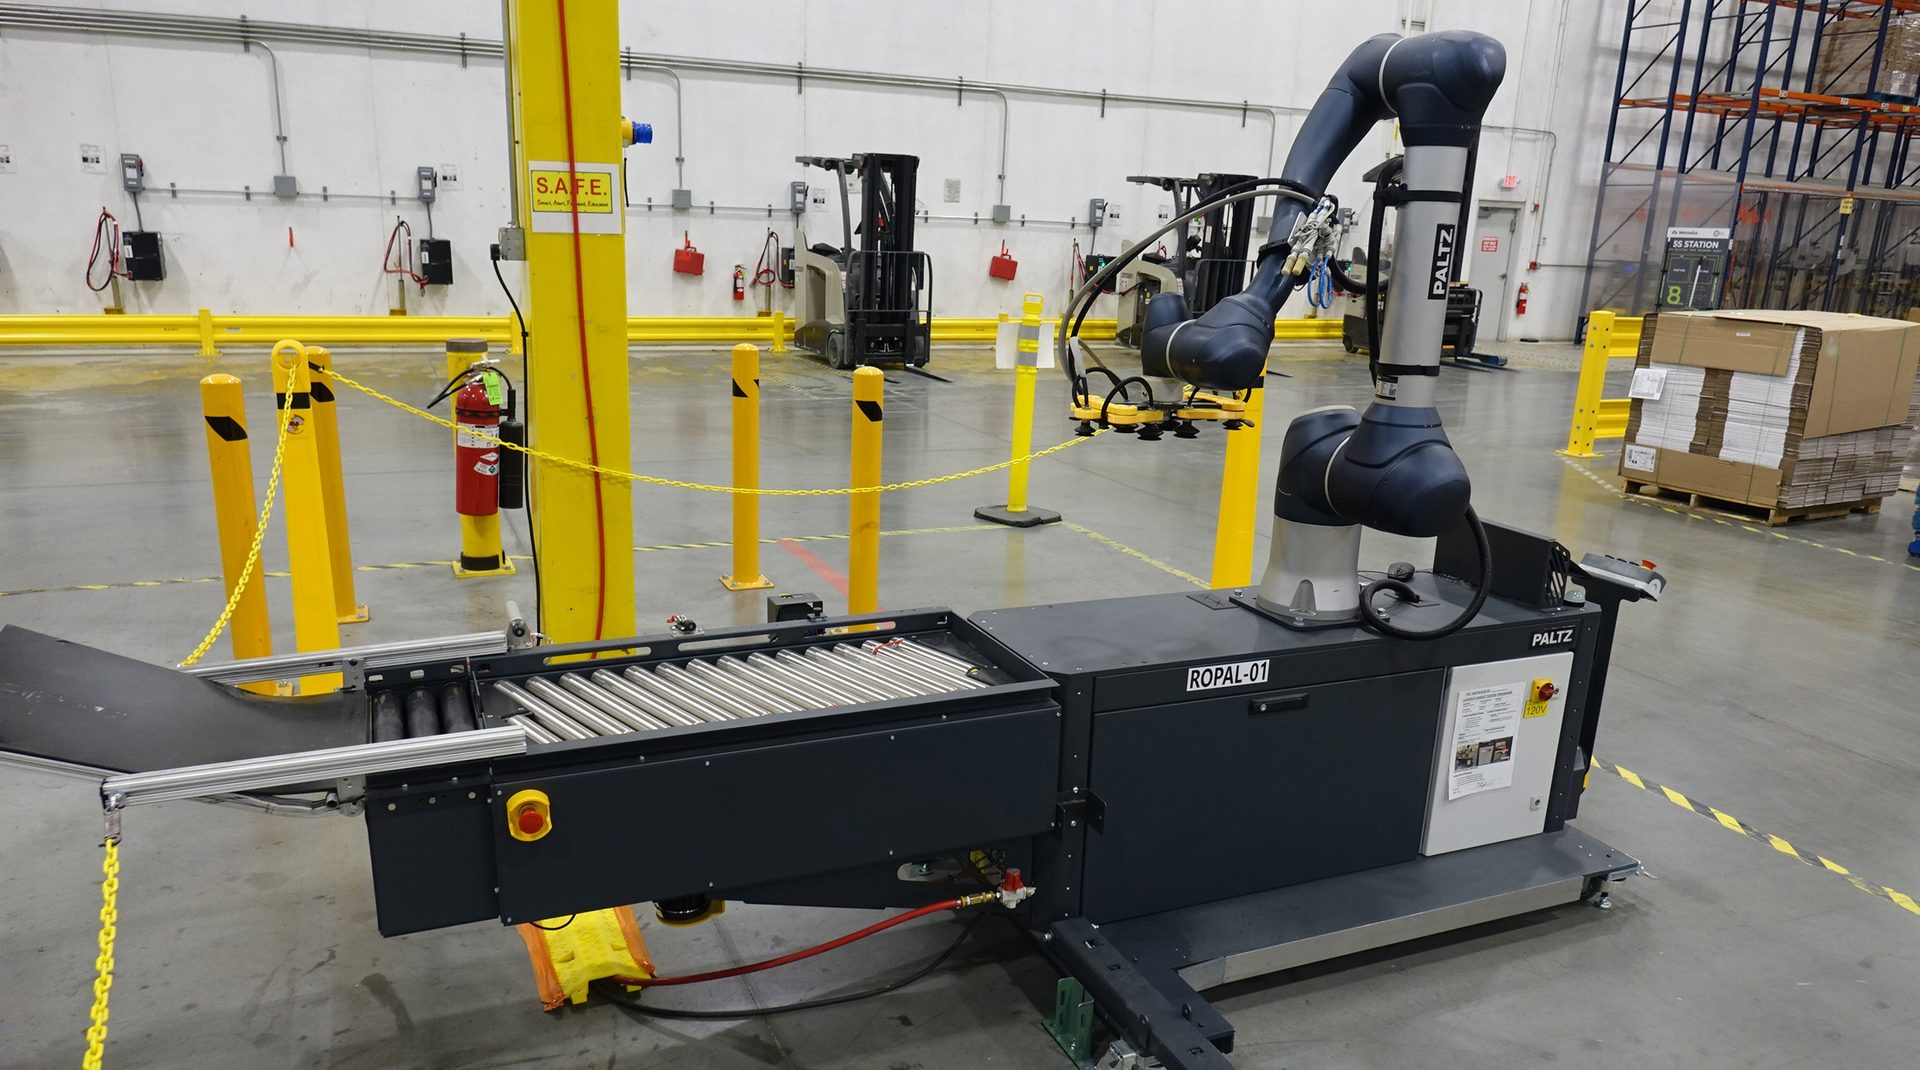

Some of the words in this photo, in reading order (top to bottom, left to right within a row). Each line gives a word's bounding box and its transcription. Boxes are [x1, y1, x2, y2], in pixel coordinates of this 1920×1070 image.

[1673, 240, 1683, 248] 5S
[1684, 240, 1719, 249] STATION
[1433, 229, 1453, 295] PALTZ
[1667, 285, 1681, 304] 8
[1532, 629, 1573, 647] PALTZ
[1190, 661, 1267, 689] ROPAL-01
[1527, 704, 1548, 716] 120V
